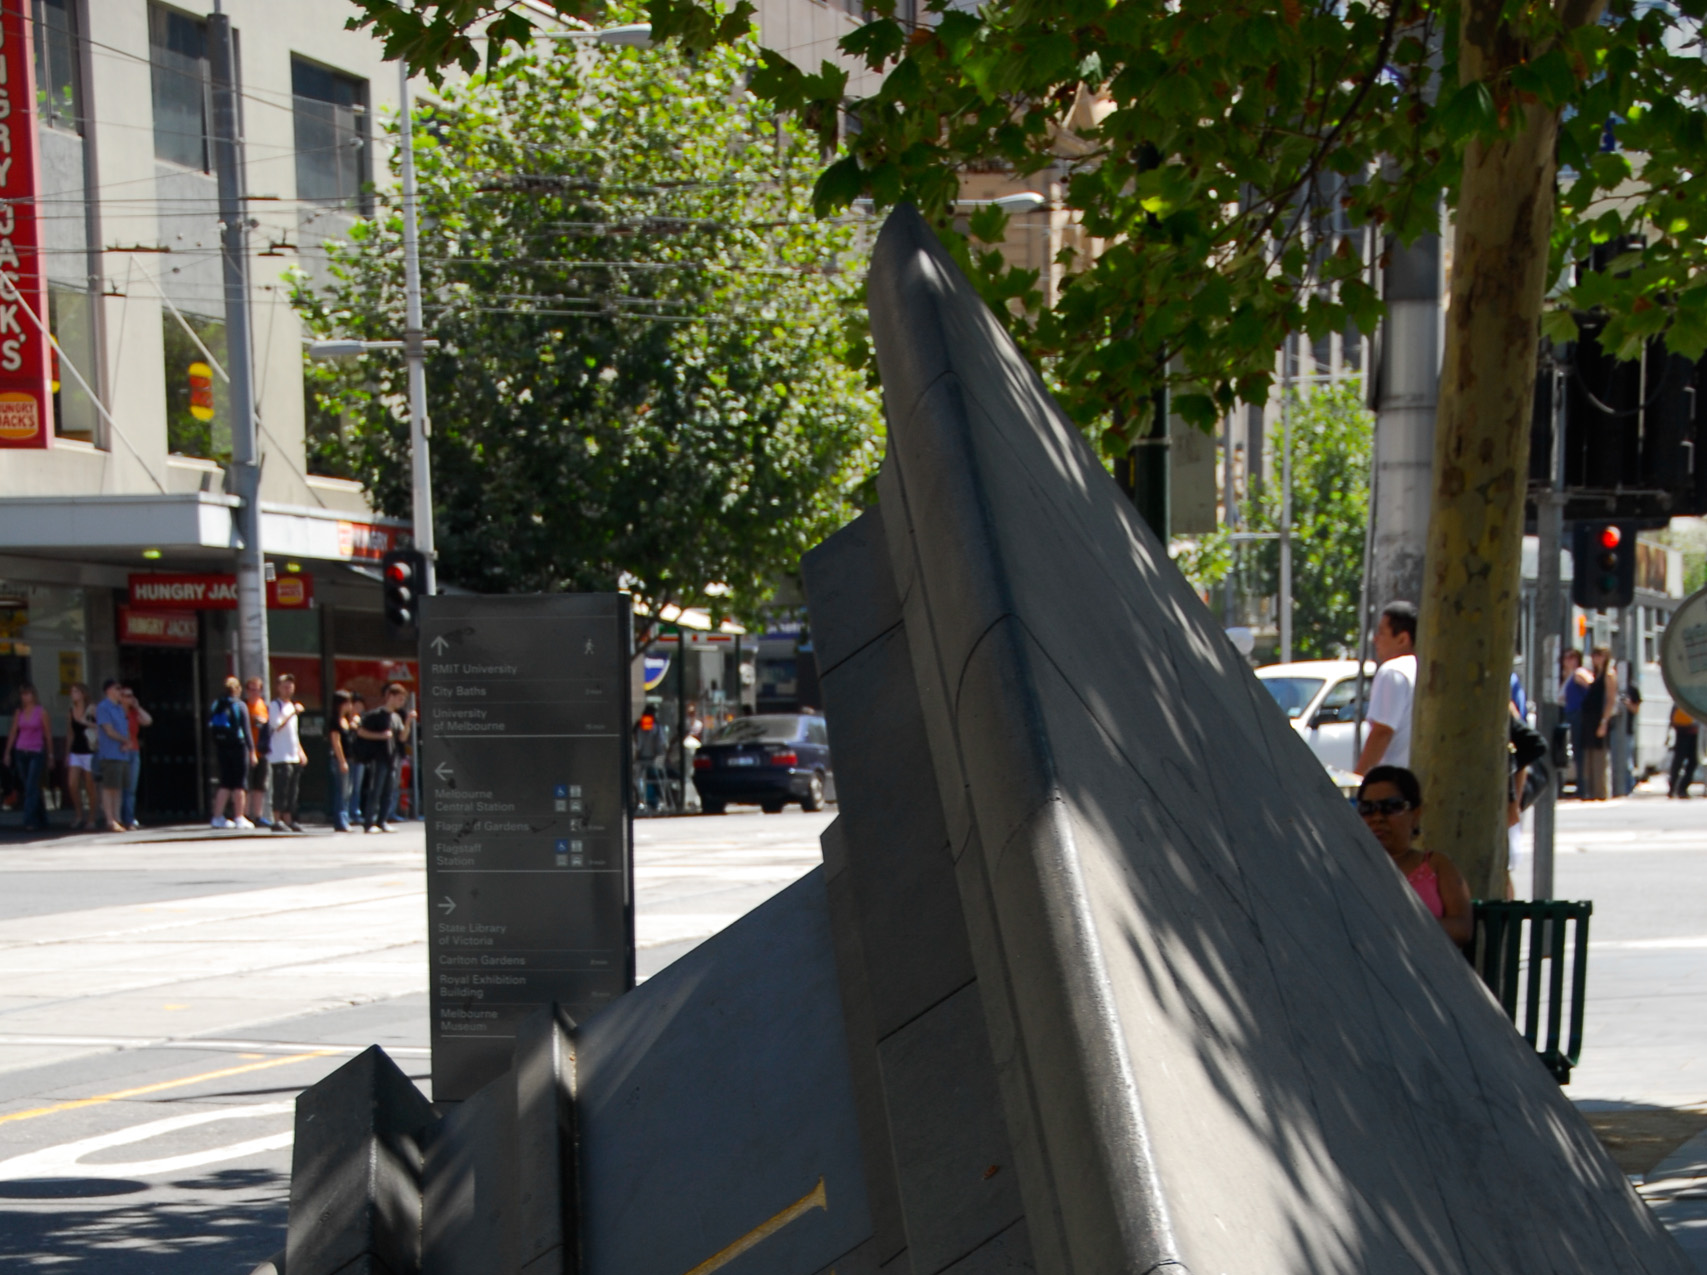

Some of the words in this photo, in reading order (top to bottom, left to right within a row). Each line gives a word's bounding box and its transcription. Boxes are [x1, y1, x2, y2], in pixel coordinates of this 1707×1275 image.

[0, 404, 33, 413] UNGRY
[135, 583, 206, 600] HUNGRY
[207, 584, 238, 600] JAC
[432, 665, 459, 674] RMIT
[463, 665, 518, 675] University
[432, 687, 454, 698] City
[456, 687, 487, 696] Baths
[432, 709, 488, 720] University
[433, 721, 445, 731] of
[447, 721, 506, 731] Melbourne
[434, 789, 493, 799] Melbourne
[435, 802, 474, 812] Central
[476, 802, 516, 812] Station
[435, 821, 482, 833] Flagff
[483, 820, 530, 832] Gardens
[436, 843, 482, 855] Flagstaff
[436, 856, 476, 866] Station
[438, 923, 466, 933] State
[468, 924, 508, 935] Library
[438, 936, 450, 945] of
[452, 936, 494, 945] Victoria
[439, 955, 478, 965] Carlton
[480, 955, 526, 965] Gardens
[440, 975, 469, 985] Royal
[472, 975, 527, 985] Exhibition
[440, 987, 484, 999] Building
[440, 1009, 498, 1018] Melbourne
[441, 1021, 487, 1031] Museum
